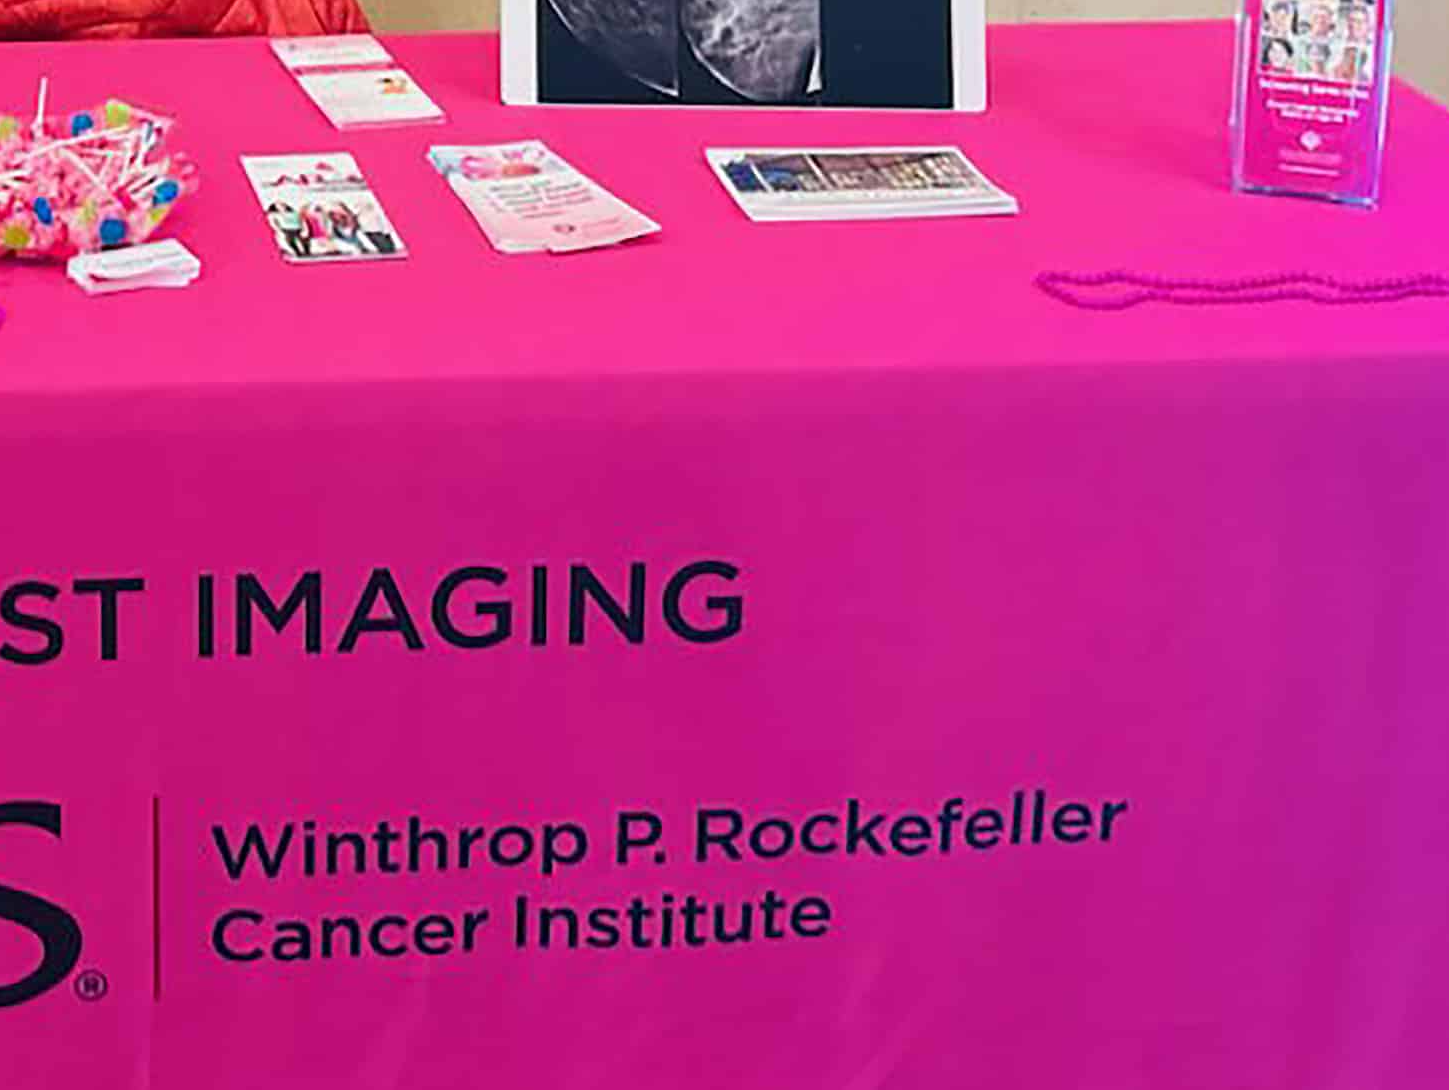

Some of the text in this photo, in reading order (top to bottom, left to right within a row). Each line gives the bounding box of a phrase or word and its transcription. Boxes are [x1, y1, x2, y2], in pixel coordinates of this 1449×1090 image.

[197, 560, 744, 659] IMAGING
[210, 788, 1129, 877] Winthrop P. Rockefeller
[210, 889, 833, 963] Cancer Institute
